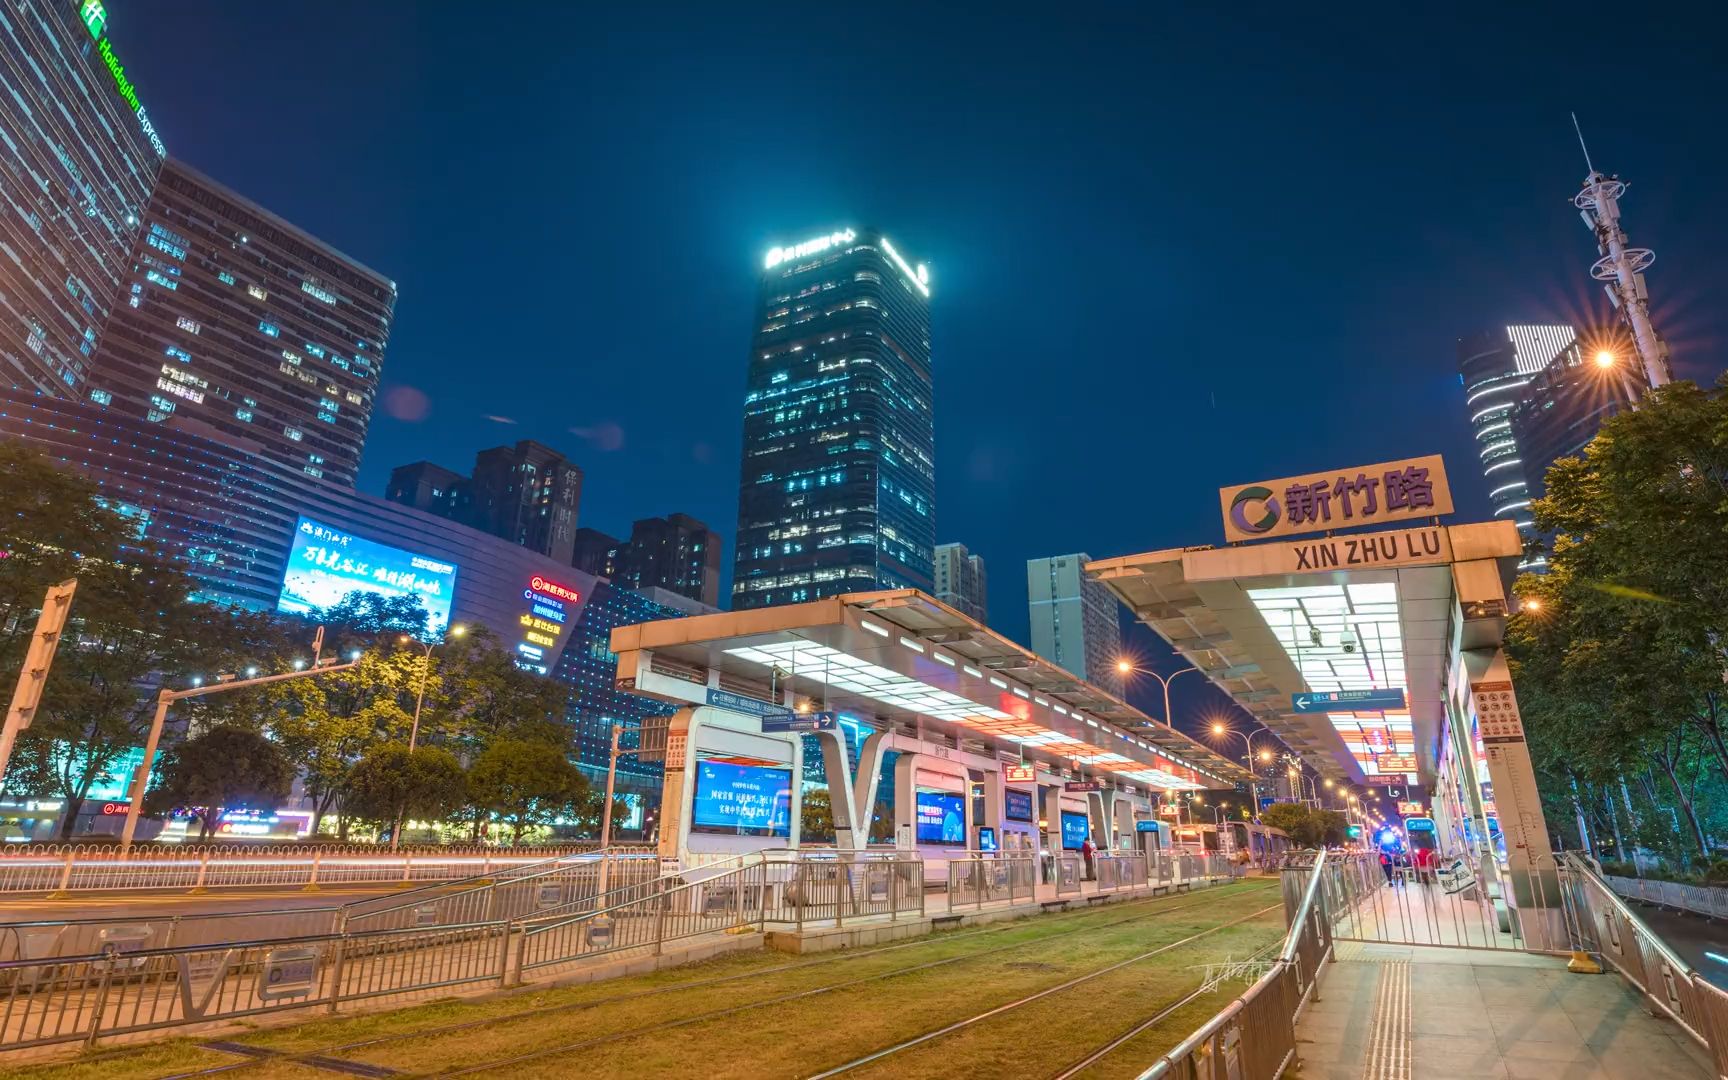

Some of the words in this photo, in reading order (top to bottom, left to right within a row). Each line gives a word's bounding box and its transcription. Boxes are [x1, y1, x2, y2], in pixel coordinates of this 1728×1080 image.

[137, 106, 166, 157] Express
[1284, 466, 1434, 527] 新竹路
[1294, 542, 1339, 570] XIN
[1344, 535, 1397, 564] ZHU
[1406, 530, 1440, 558] LU
[542, 582, 578, 602] 海底捞火锅
